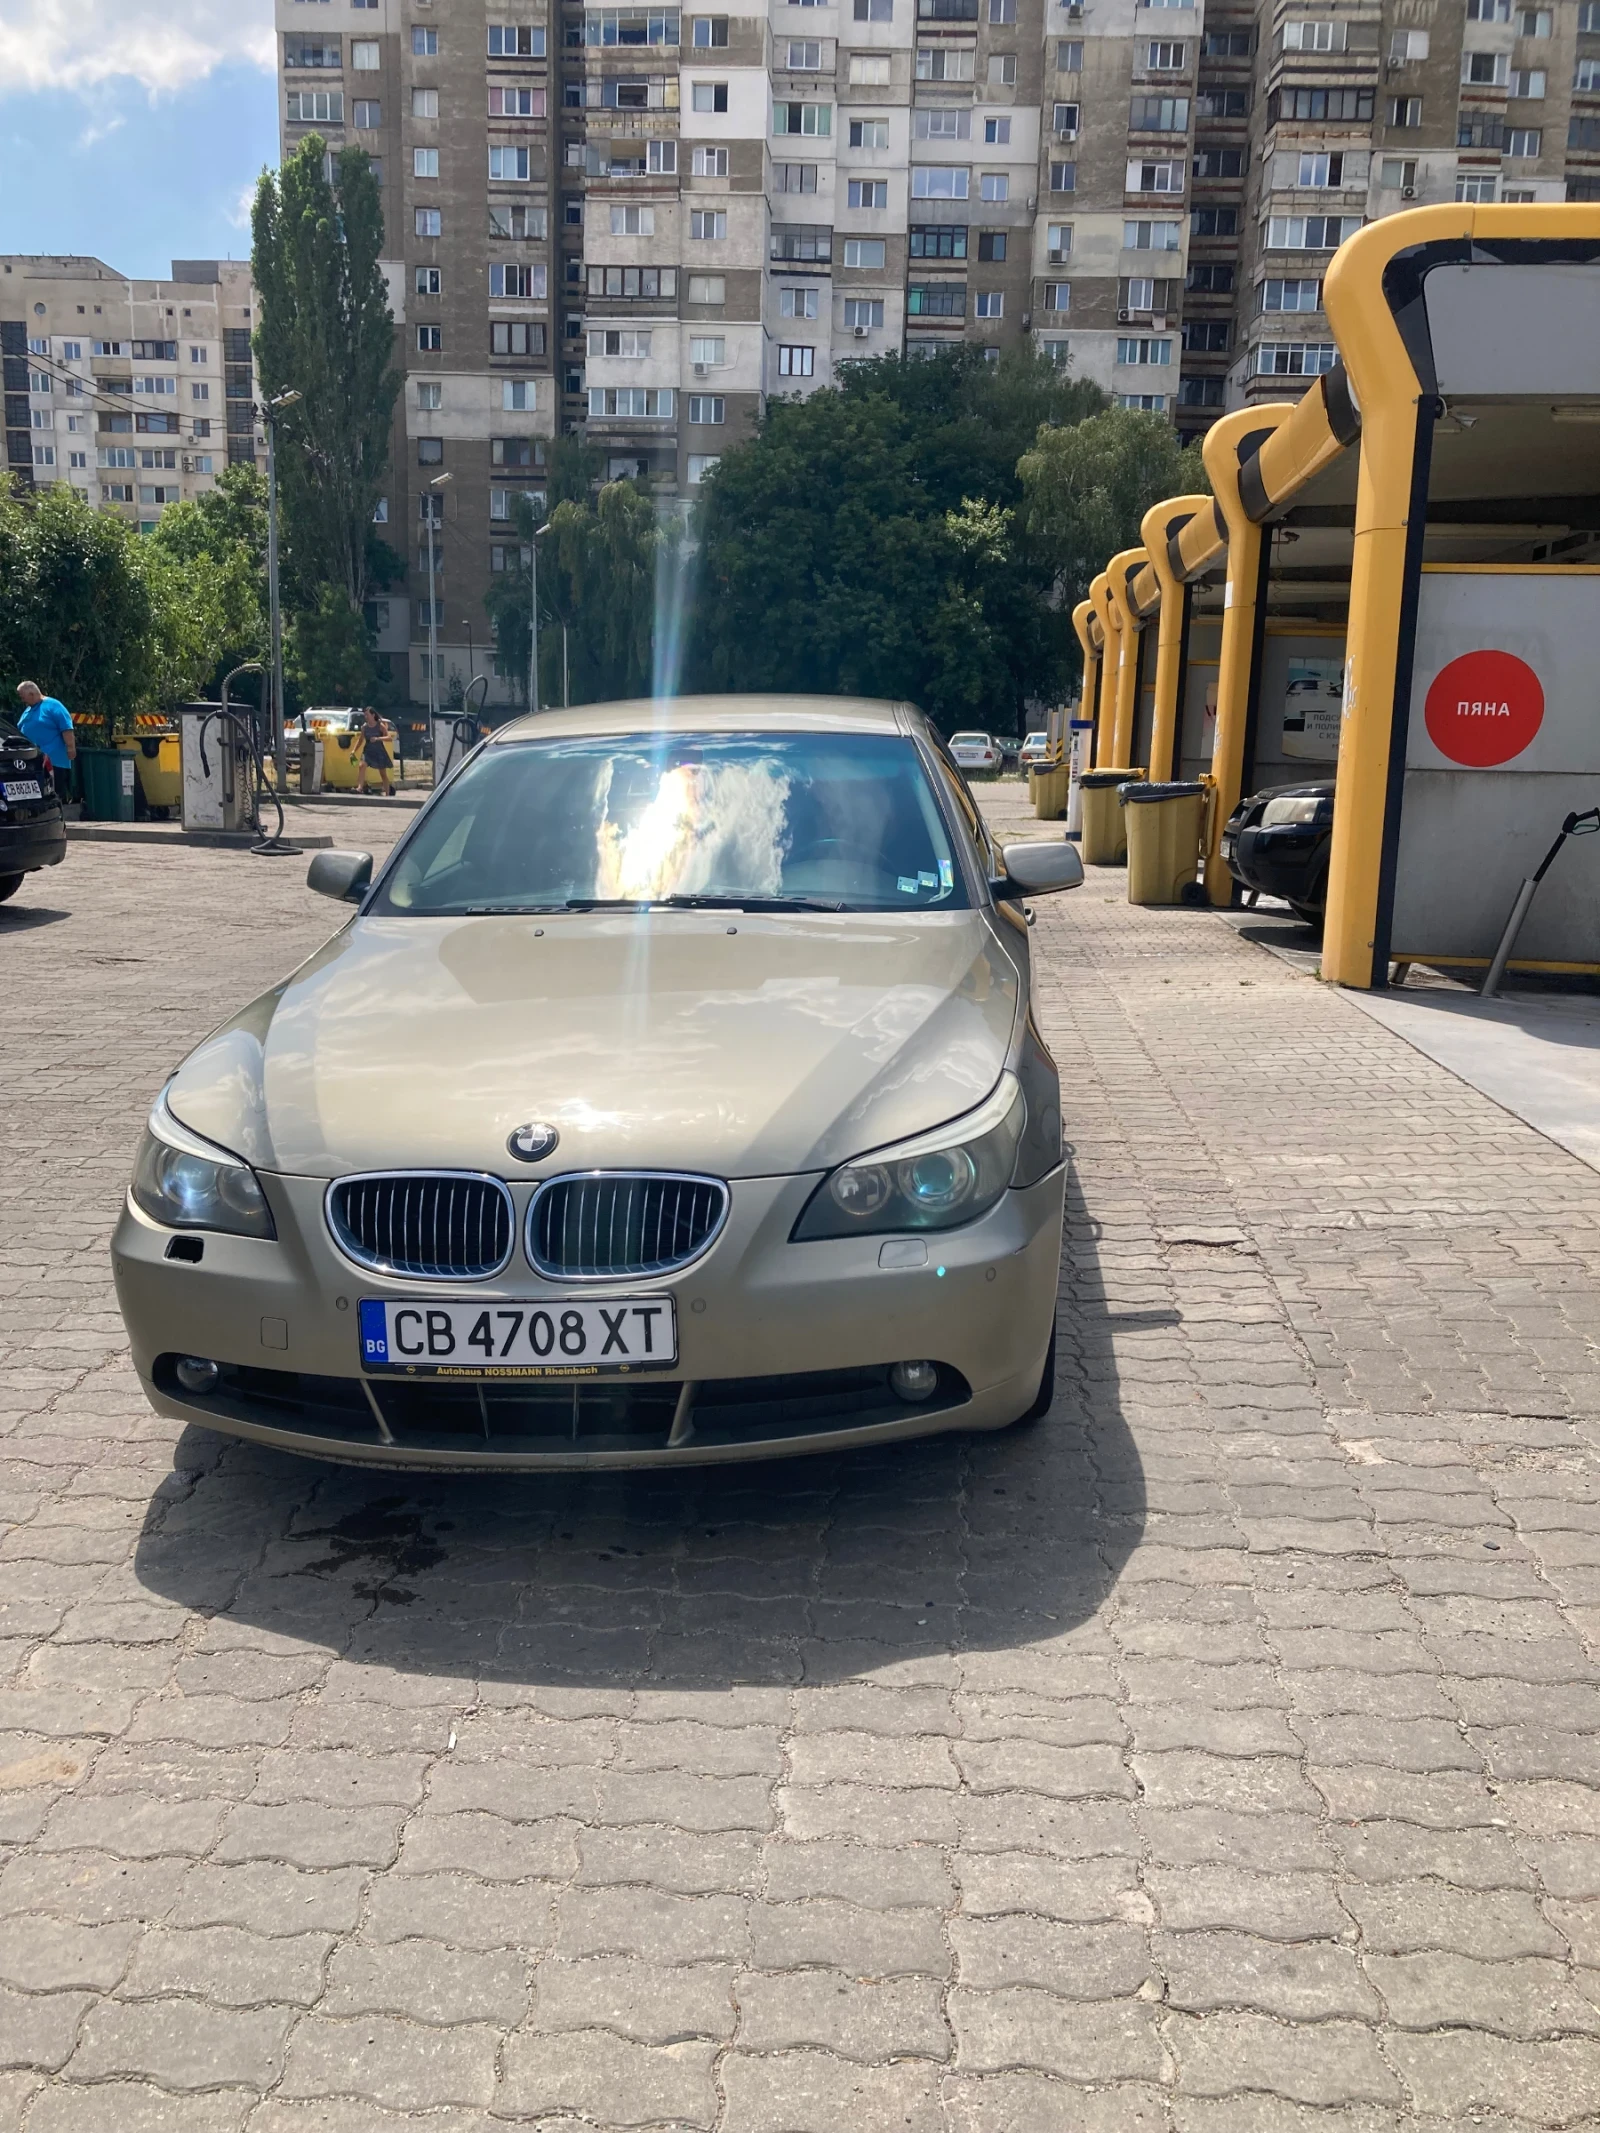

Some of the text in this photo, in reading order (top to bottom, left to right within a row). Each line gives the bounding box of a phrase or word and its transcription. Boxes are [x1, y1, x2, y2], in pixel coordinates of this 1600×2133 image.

[1457, 701, 1510, 716] ПЯНА
[395, 1308, 662, 1357] CB 4708 XT
[366, 1339, 386, 1354] BG
[436, 1366, 598, 1377] Autohaus NOSSMANN Rheinbach
